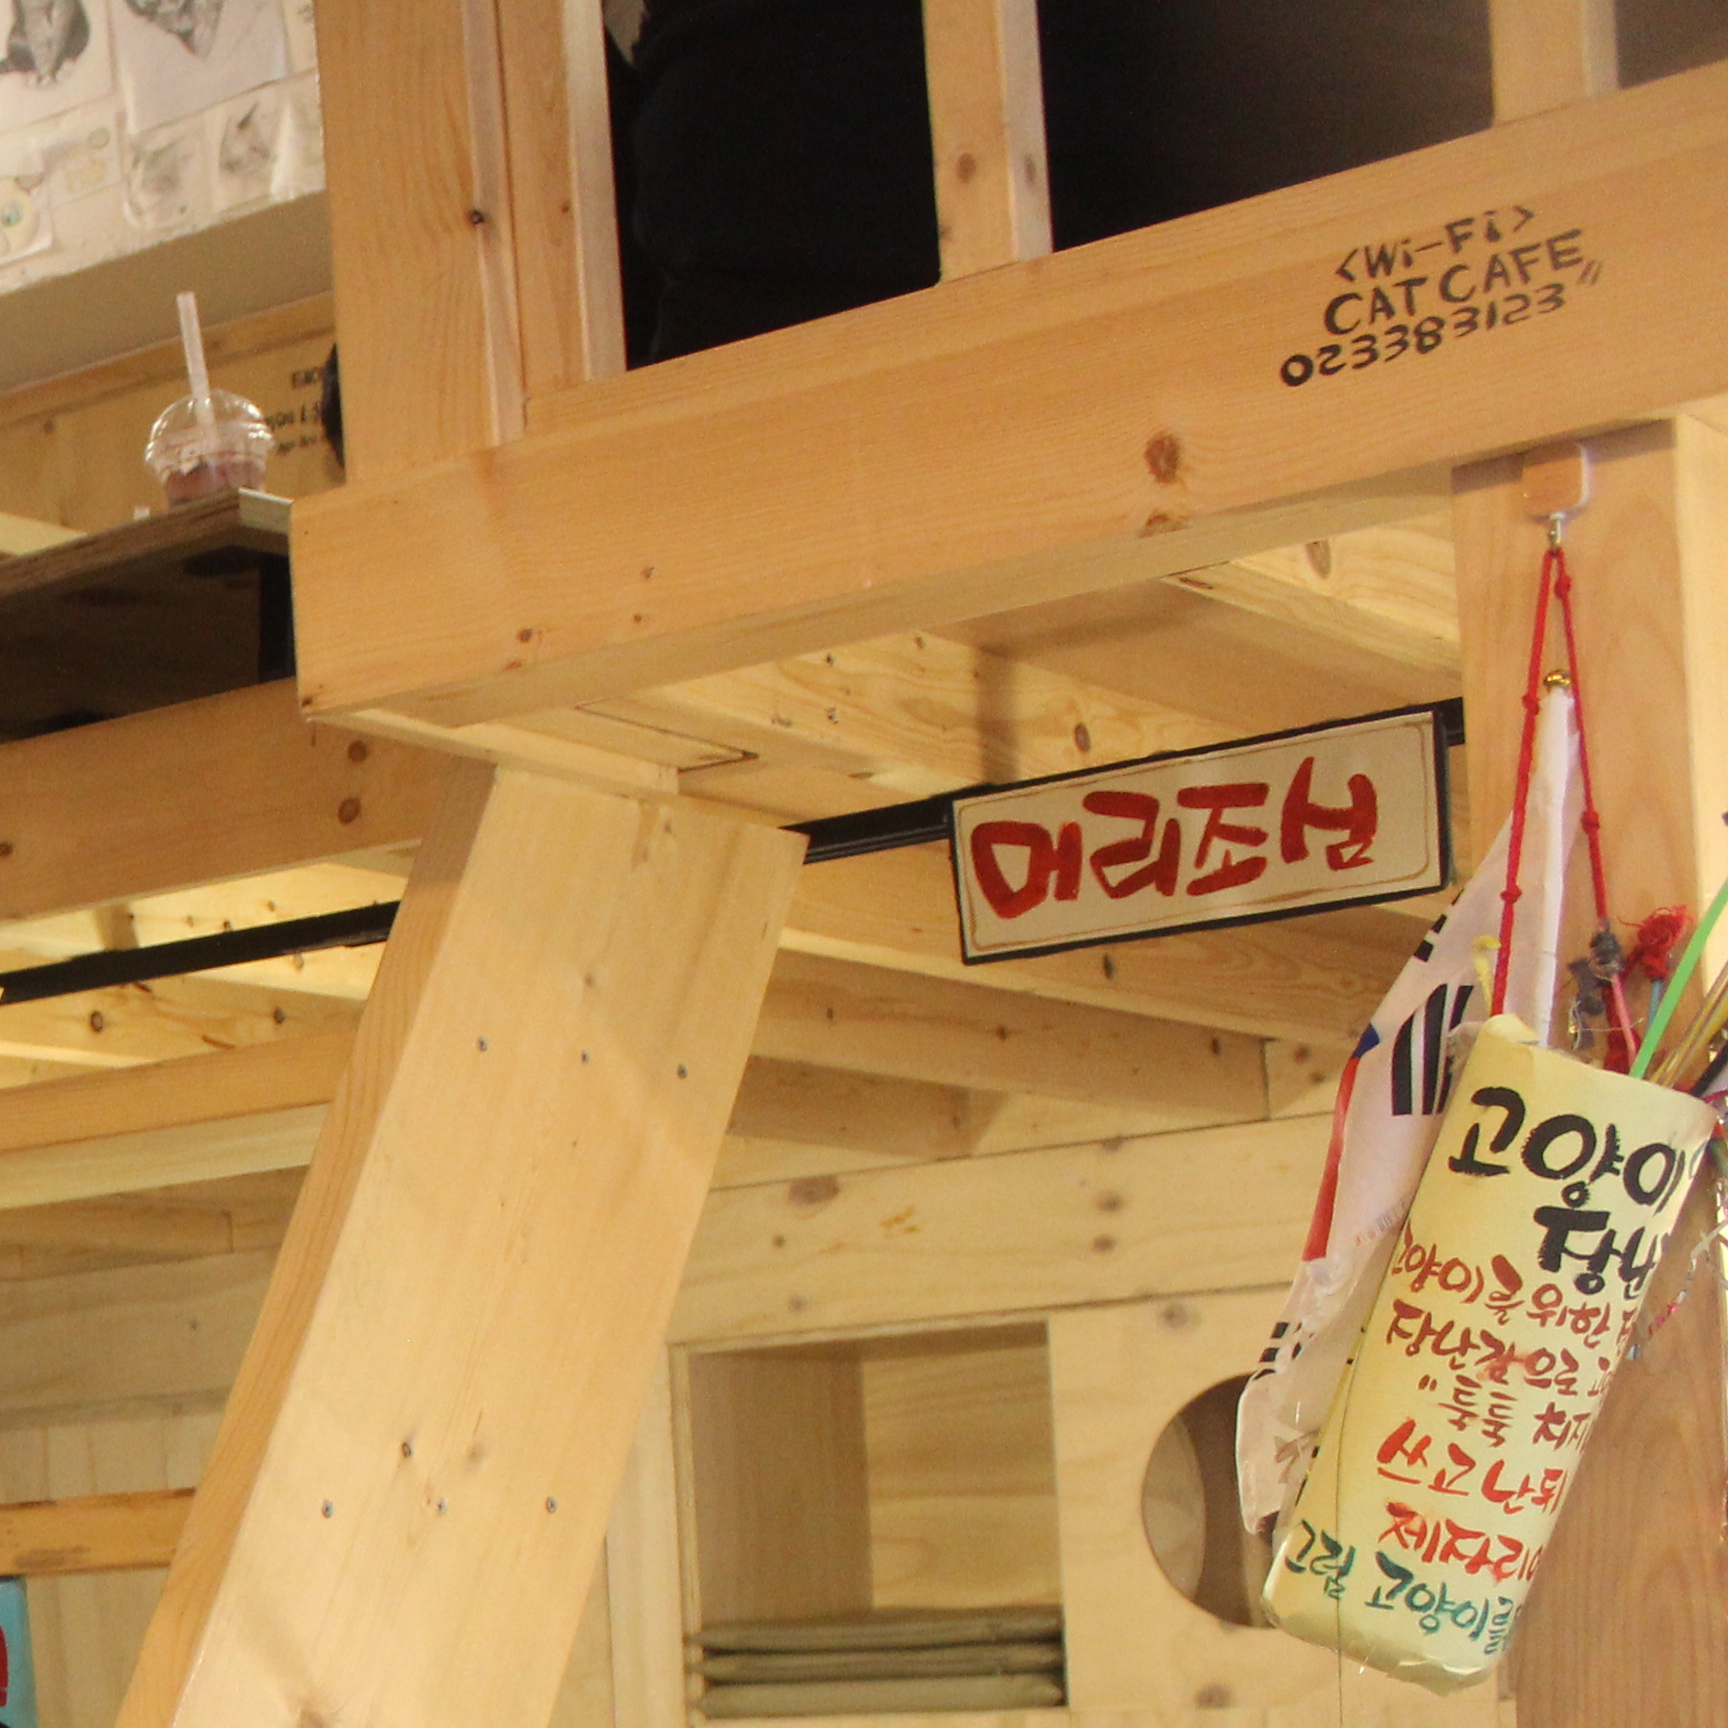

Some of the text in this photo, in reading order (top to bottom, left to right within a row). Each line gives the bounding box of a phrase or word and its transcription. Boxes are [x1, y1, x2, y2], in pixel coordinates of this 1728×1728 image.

[1280, 283, 1566, 387] 023383123
[971, 756, 1377, 919] 머리조심
[1449, 1087, 1686, 1216] 고양이
